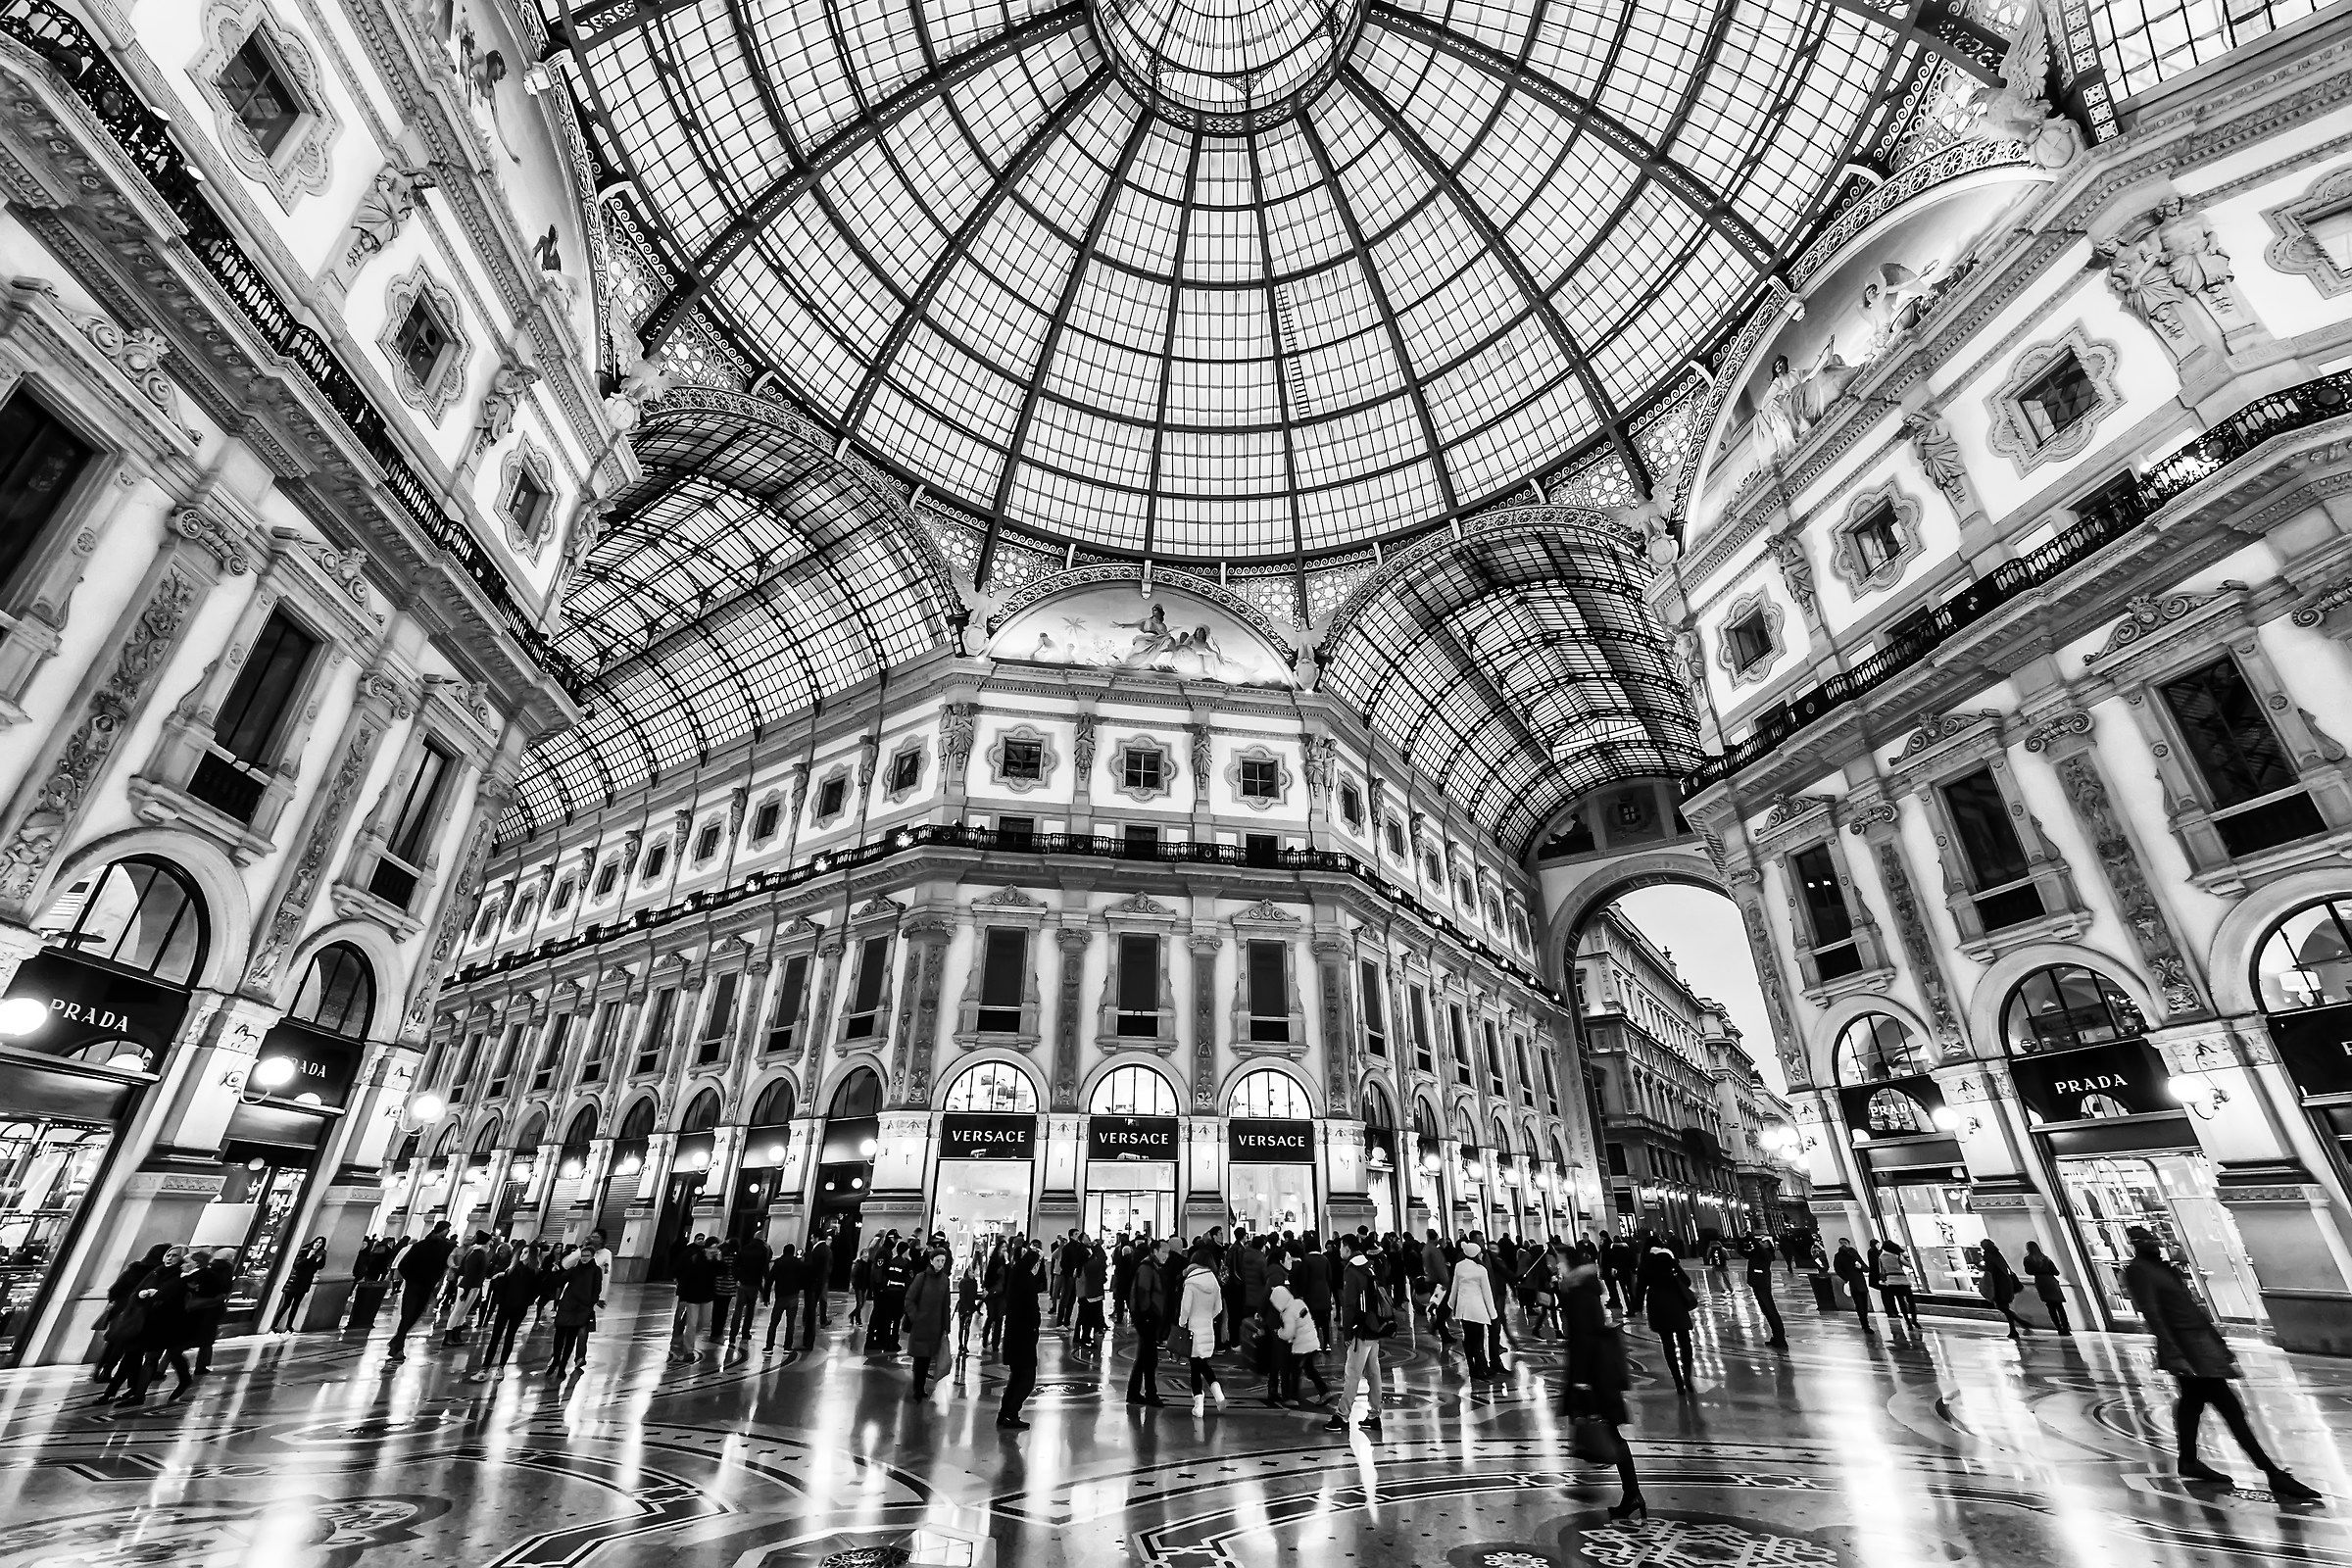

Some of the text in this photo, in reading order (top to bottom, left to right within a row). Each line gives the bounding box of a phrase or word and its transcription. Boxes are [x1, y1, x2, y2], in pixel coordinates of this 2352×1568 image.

[48, 998, 128, 1033] PRADA
[2054, 1073, 2129, 1095] PRADA
[952, 1130, 1026, 1143] VERSACE
[1099, 1132, 1169, 1145] VERSACE
[1238, 1134, 1305, 1148] VERSACE
